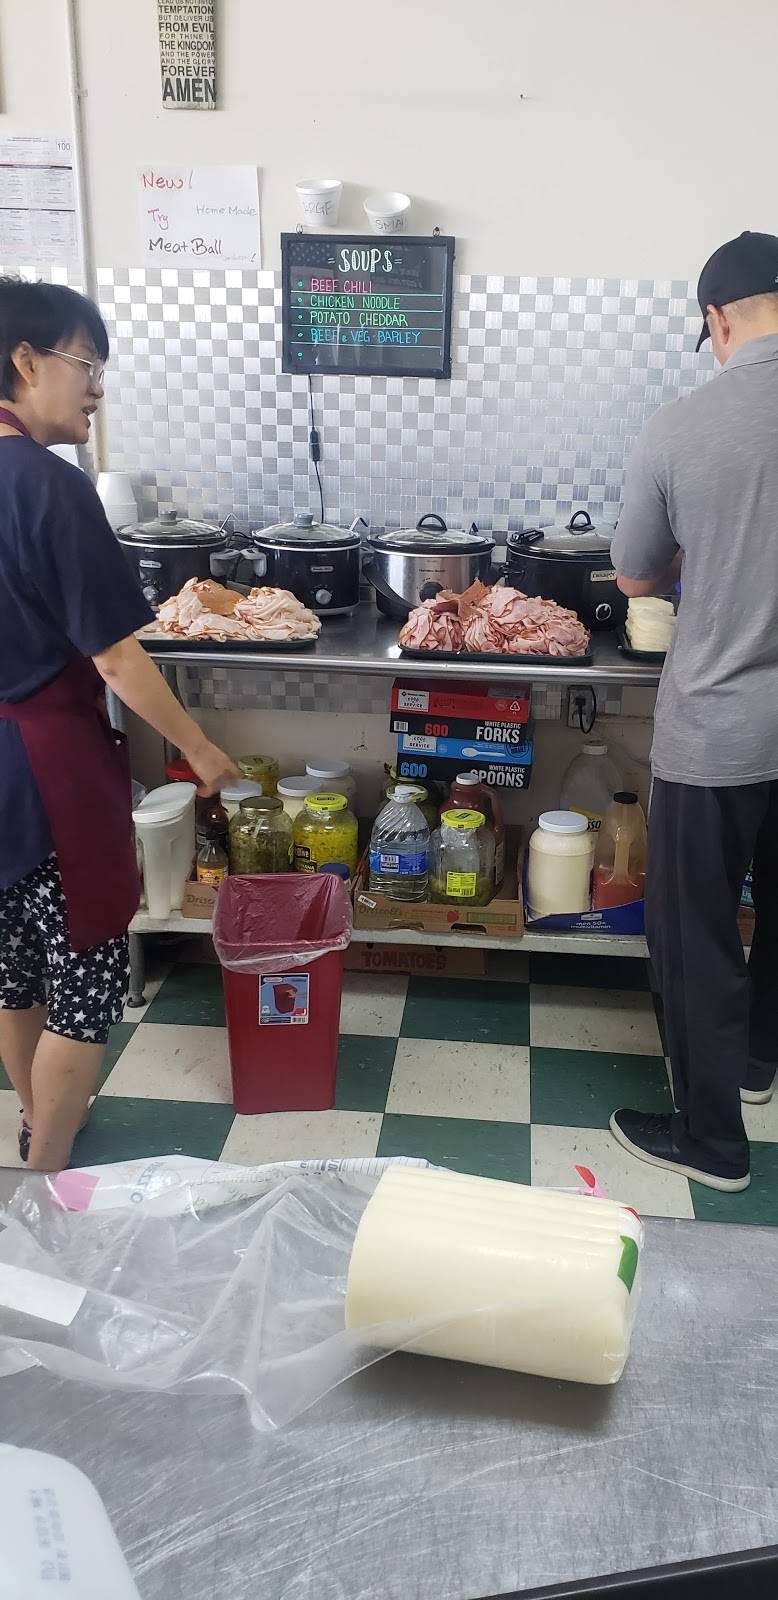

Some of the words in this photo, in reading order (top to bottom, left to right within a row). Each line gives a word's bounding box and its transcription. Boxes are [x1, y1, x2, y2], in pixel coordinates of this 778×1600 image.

[158, 5, 214, 15] TEMPTATION
[159, 22, 189, 32] FROM
[192, 22, 215, 33] EVIL
[160, 40, 176, 50] THE
[178, 41, 215, 51] KINGDOM
[161, 65, 216, 77] FOREVER
[162, 77, 217, 103] AMEN
[57, 142, 71, 151] 100
[147, 207, 169, 231] Try
[149, 237, 189, 254] Meat
[191, 237, 222, 256] Ball
[339, 248, 392, 272] SOUPS
[311, 278, 340, 292] BEEF
[343, 280, 373, 294] CHILI
[310, 295, 355, 309] CHICKEN
[362, 296, 401, 310] NOODLE
[310, 310, 351, 325] POTATO
[359, 312, 409, 327] CHEDDAR
[310, 328, 339, 343] BEEF
[424, 723, 449, 737] 600
[484, 720, 501, 729] WHITE
[501, 721, 522, 730] PLASTIC
[475, 726, 520, 744] FORKS
[400, 761, 428, 778] 600
[488, 764, 504, 772] WHITE
[505, 766, 526, 774] PLASTIC
[361, 951, 448, 970] TOMATOES
